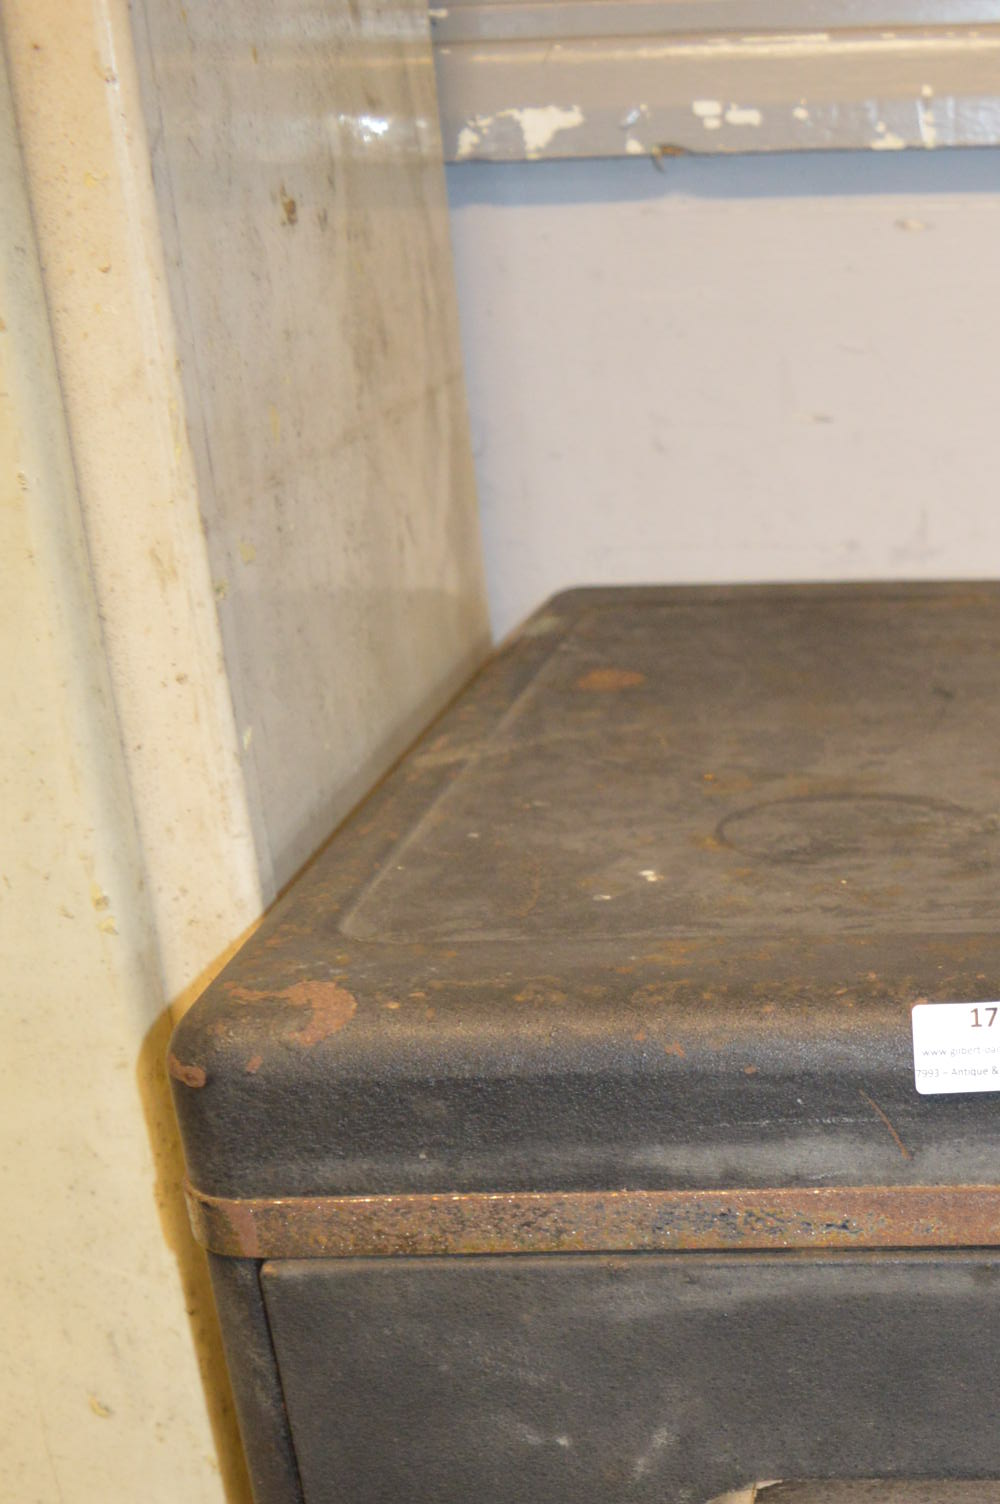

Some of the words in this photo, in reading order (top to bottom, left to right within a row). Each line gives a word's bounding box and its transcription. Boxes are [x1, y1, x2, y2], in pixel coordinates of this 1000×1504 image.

[970, 1007, 998, 1028] 17
[951, 1067, 988, 1078] Antique
[991, 1066, 999, 1075] &
